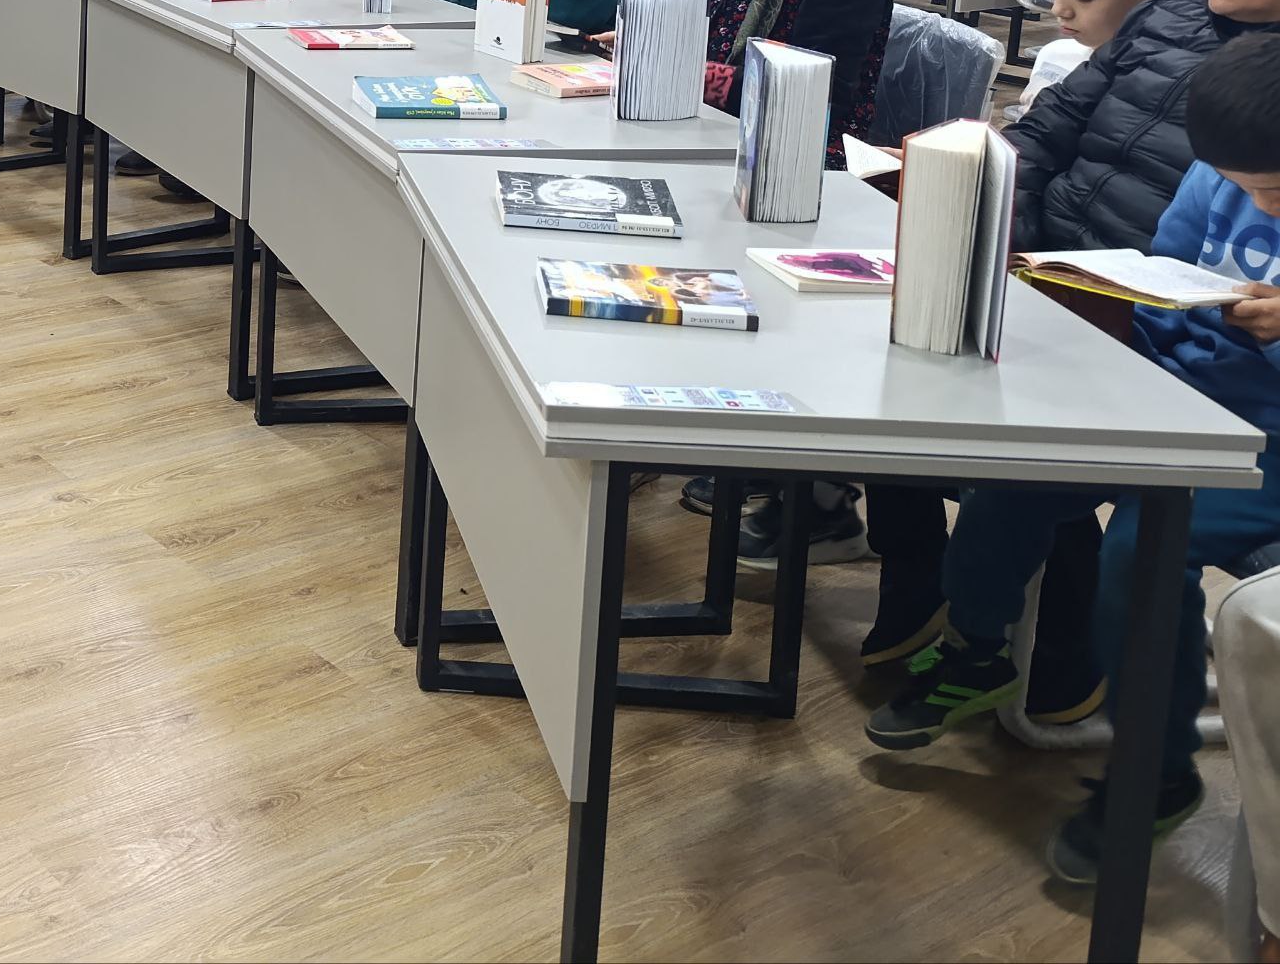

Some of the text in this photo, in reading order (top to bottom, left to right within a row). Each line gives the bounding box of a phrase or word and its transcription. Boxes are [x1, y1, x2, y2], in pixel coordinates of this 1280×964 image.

[510, 177, 537, 206] БОНУ
[535, 217, 612, 231] МИРЗО БОНУ
